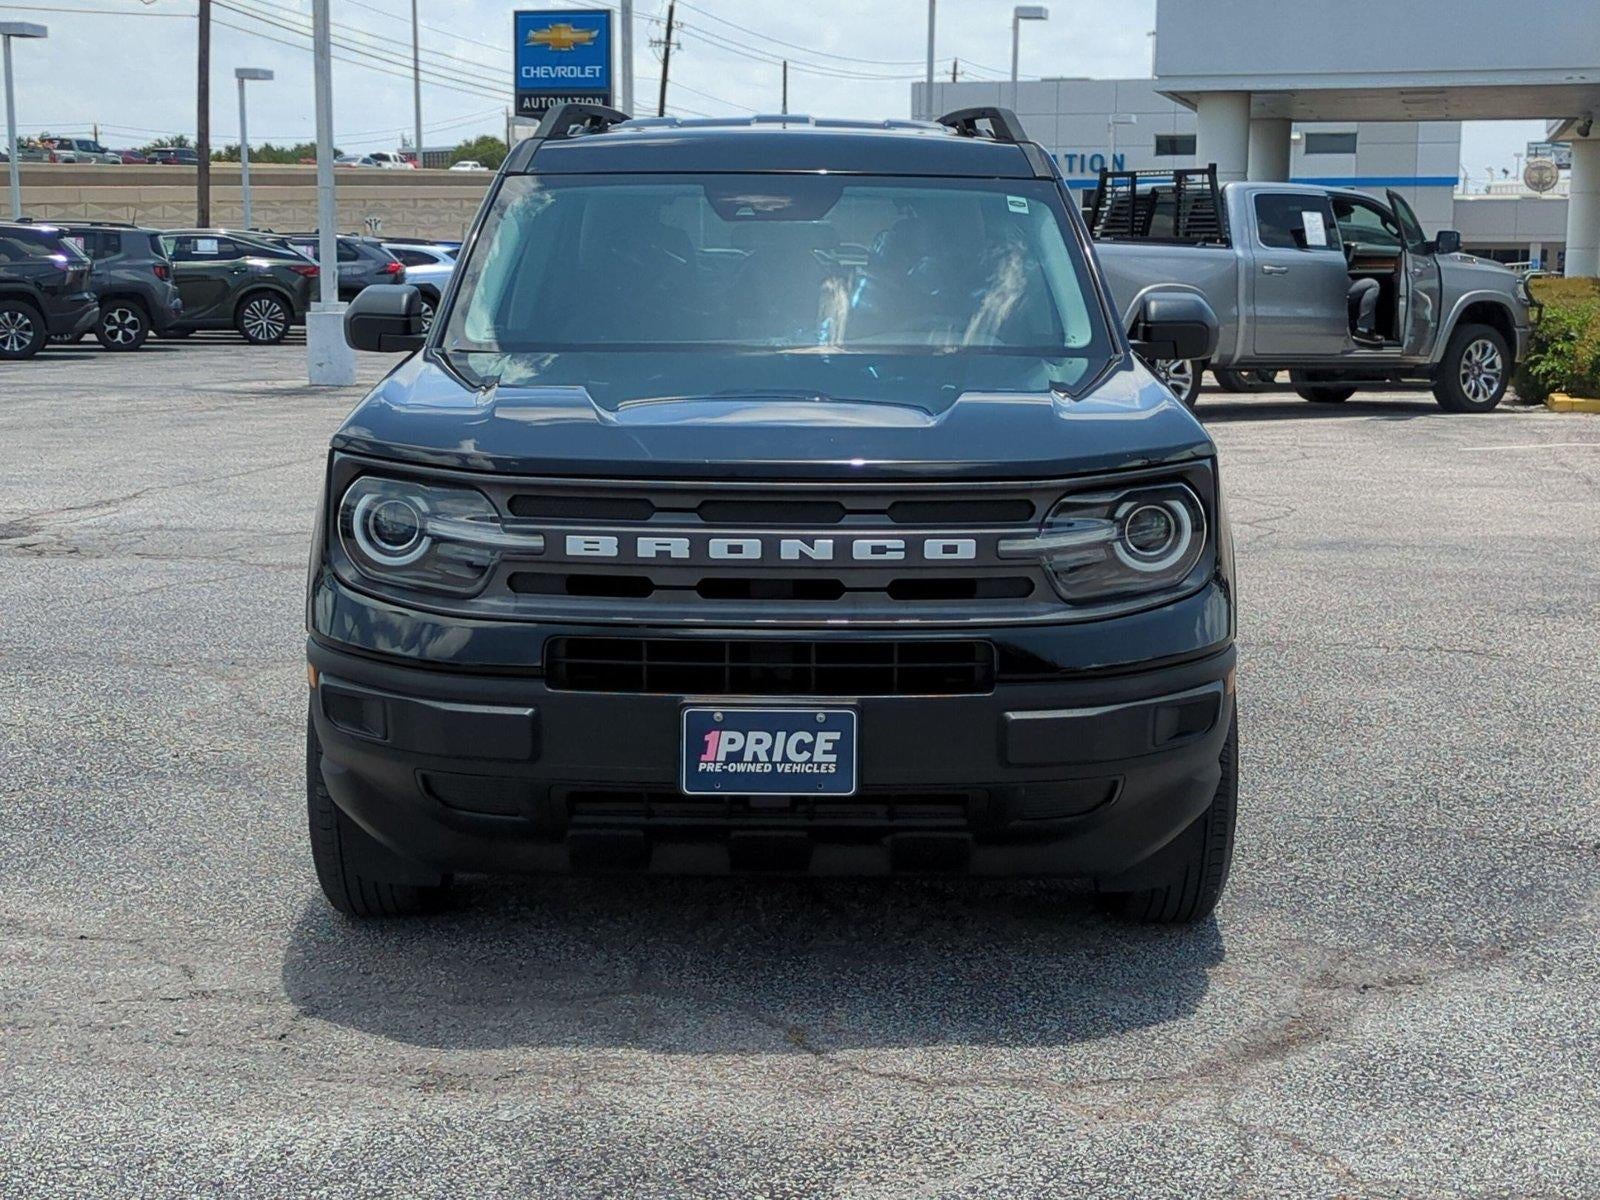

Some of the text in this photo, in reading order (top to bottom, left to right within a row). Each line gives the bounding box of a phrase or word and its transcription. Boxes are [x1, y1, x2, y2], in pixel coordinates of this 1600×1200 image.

[521, 65, 602, 78] CHEVROLET
[565, 534, 977, 560] BRONCO
[700, 730, 842, 763] 1PRICE
[698, 762, 837, 774] PRE-OWNED VEHICLES
